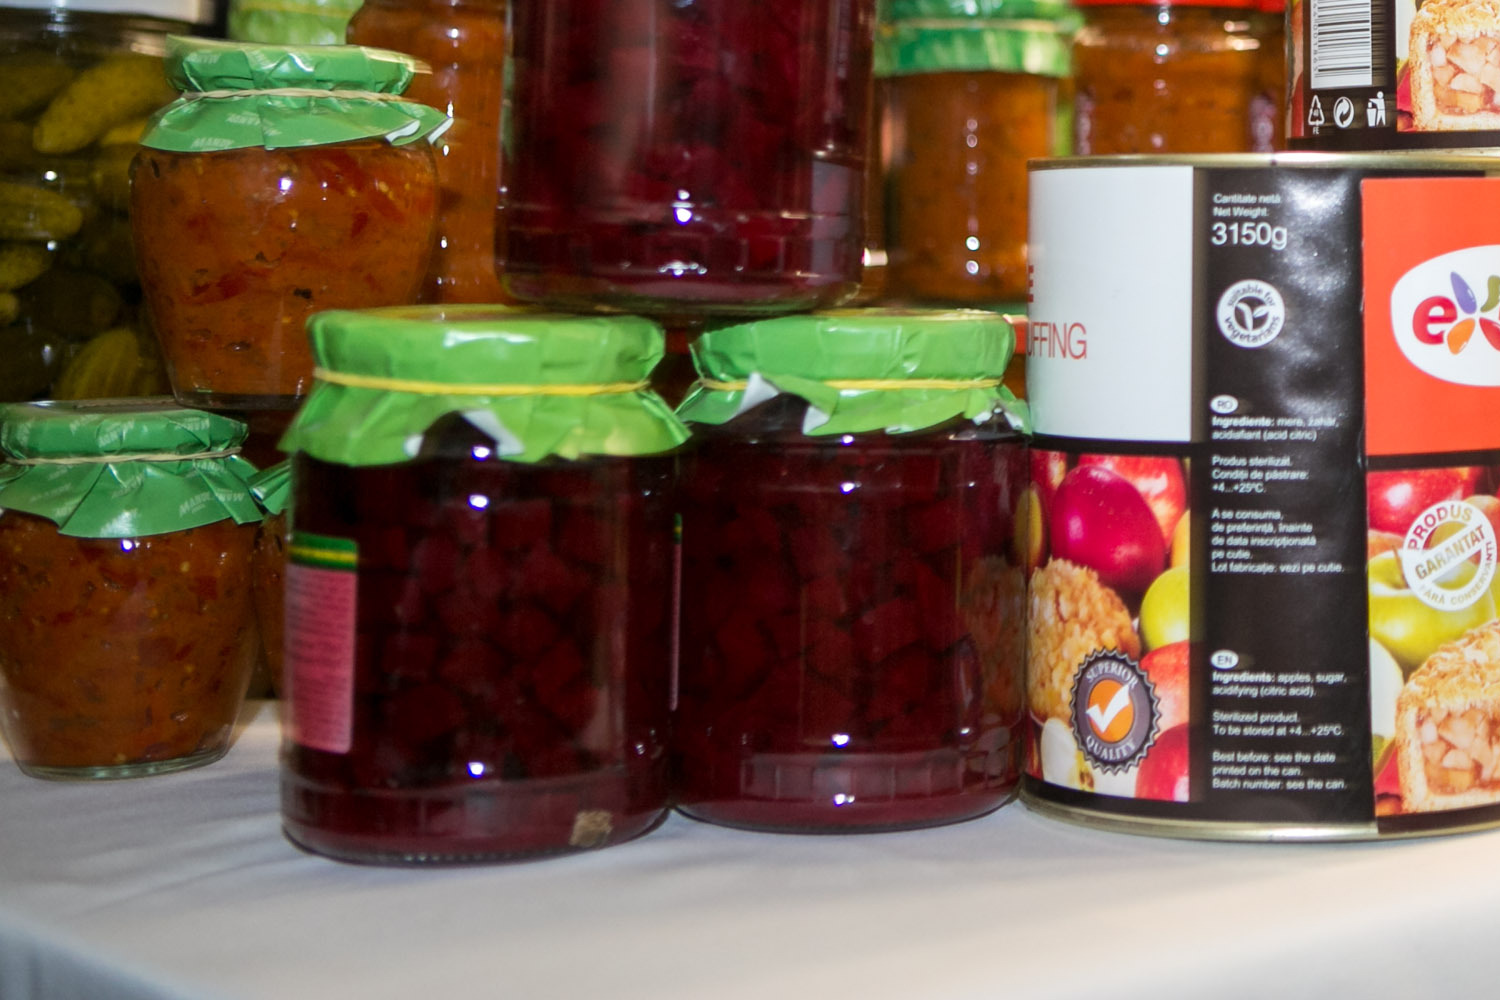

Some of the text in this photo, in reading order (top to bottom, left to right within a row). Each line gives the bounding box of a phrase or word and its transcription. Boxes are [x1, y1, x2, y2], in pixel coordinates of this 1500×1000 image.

[1212, 207, 1231, 217] Net
[1211, 222, 1288, 250] 3150g
[1224, 315, 1281, 343] vegetarians
[1212, 456, 1247, 467] Produs
[1250, 469, 1263, 479] de
[1211, 508, 1220, 519] A
[1221, 510, 1233, 519] se
[1211, 522, 1224, 532] de
[1408, 504, 1473, 551] PRODUS
[1211, 536, 1224, 546] de
[1226, 536, 1249, 546] data
[1211, 550, 1225, 560] pe
[1415, 525, 1485, 580] GARANTAT
[1211, 562, 1227, 573] Lot
[1279, 562, 1300, 573] vezi
[1302, 563, 1315, 574] pe
[1217, 655, 1232, 665] EN
[1086, 661, 1139, 690] SUPERIOR
[1212, 671, 1275, 684] Ingredients:
[1212, 711, 1258, 722] Sterilized
[1213, 724, 1225, 735] To
[1227, 724, 1241, 735] be
[1243, 725, 1274, 735] stored
[1276, 725, 1287, 735] at
[1085, 735, 1136, 761] QUALITY
[1212, 751, 1235, 762] Best
[1274, 753, 1292, 762] see
[1294, 752, 1310, 762] the
[1313, 752, 1336, 763] date
[1212, 766, 1246, 777] printed
[1248, 766, 1261, 776] on
[1263, 766, 1280, 776] the
[1212, 778, 1241, 789] Batch
[1286, 780, 1305, 789] see
[1307, 779, 1323, 789] the
